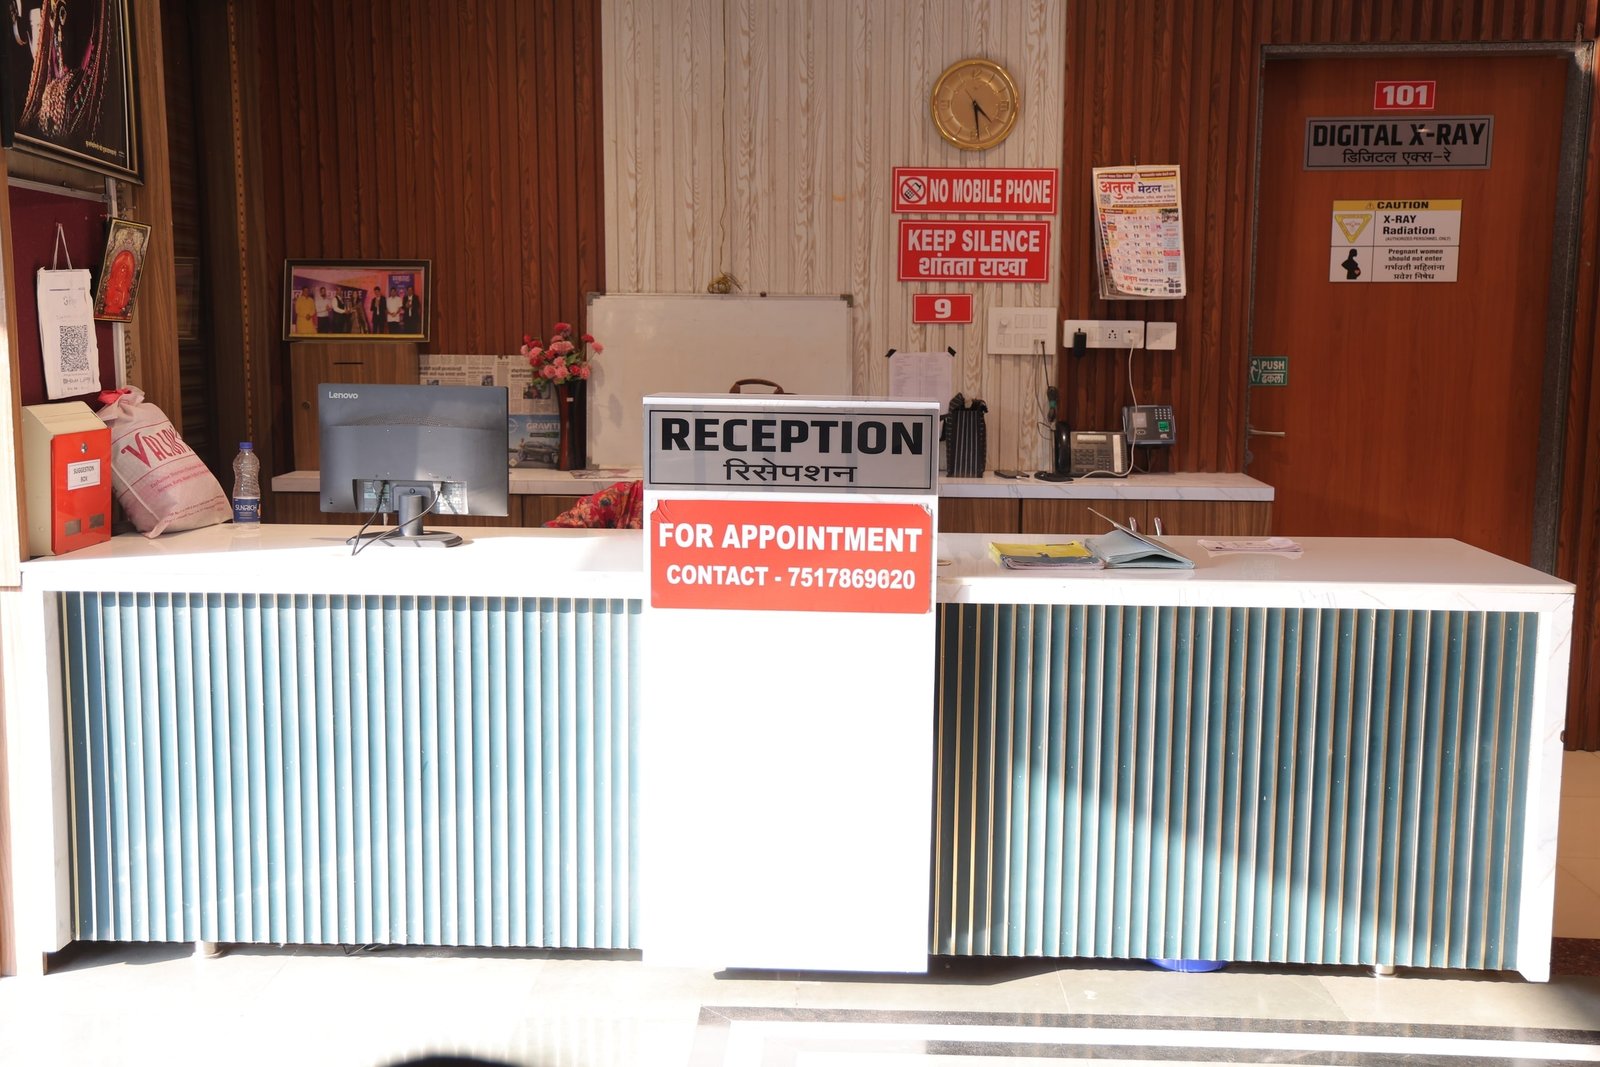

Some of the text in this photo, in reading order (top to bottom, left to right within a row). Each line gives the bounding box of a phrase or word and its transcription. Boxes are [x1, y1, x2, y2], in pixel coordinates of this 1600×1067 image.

[1382, 85, 1428, 106] 101
[1313, 123, 1486, 146] DIGITAL X-RAY
[1343, 147, 1451, 165] डिजिटल एक्स-रे
[929, 179, 1051, 204] NO MOBILE PHONE
[1099, 181, 1136, 200] अतुल
[1377, 201, 1429, 209] CAUTION
[1383, 215, 1417, 224] X-RAY
[908, 229, 1040, 252] KEEP SILENCE
[1383, 226, 1435, 235] Radiation
[918, 252, 1028, 276] शांतता राखा
[934, 298, 952, 319] 9
[1261, 360, 1285, 370] PUSH
[328, 391, 359, 399] Lenovo
[661, 417, 924, 455] RECEPTION
[722, 457, 858, 483] रिसेपशन
[659, 522, 923, 552] FOR APPOINTMENT
[666, 565, 769, 586] CONTACT
